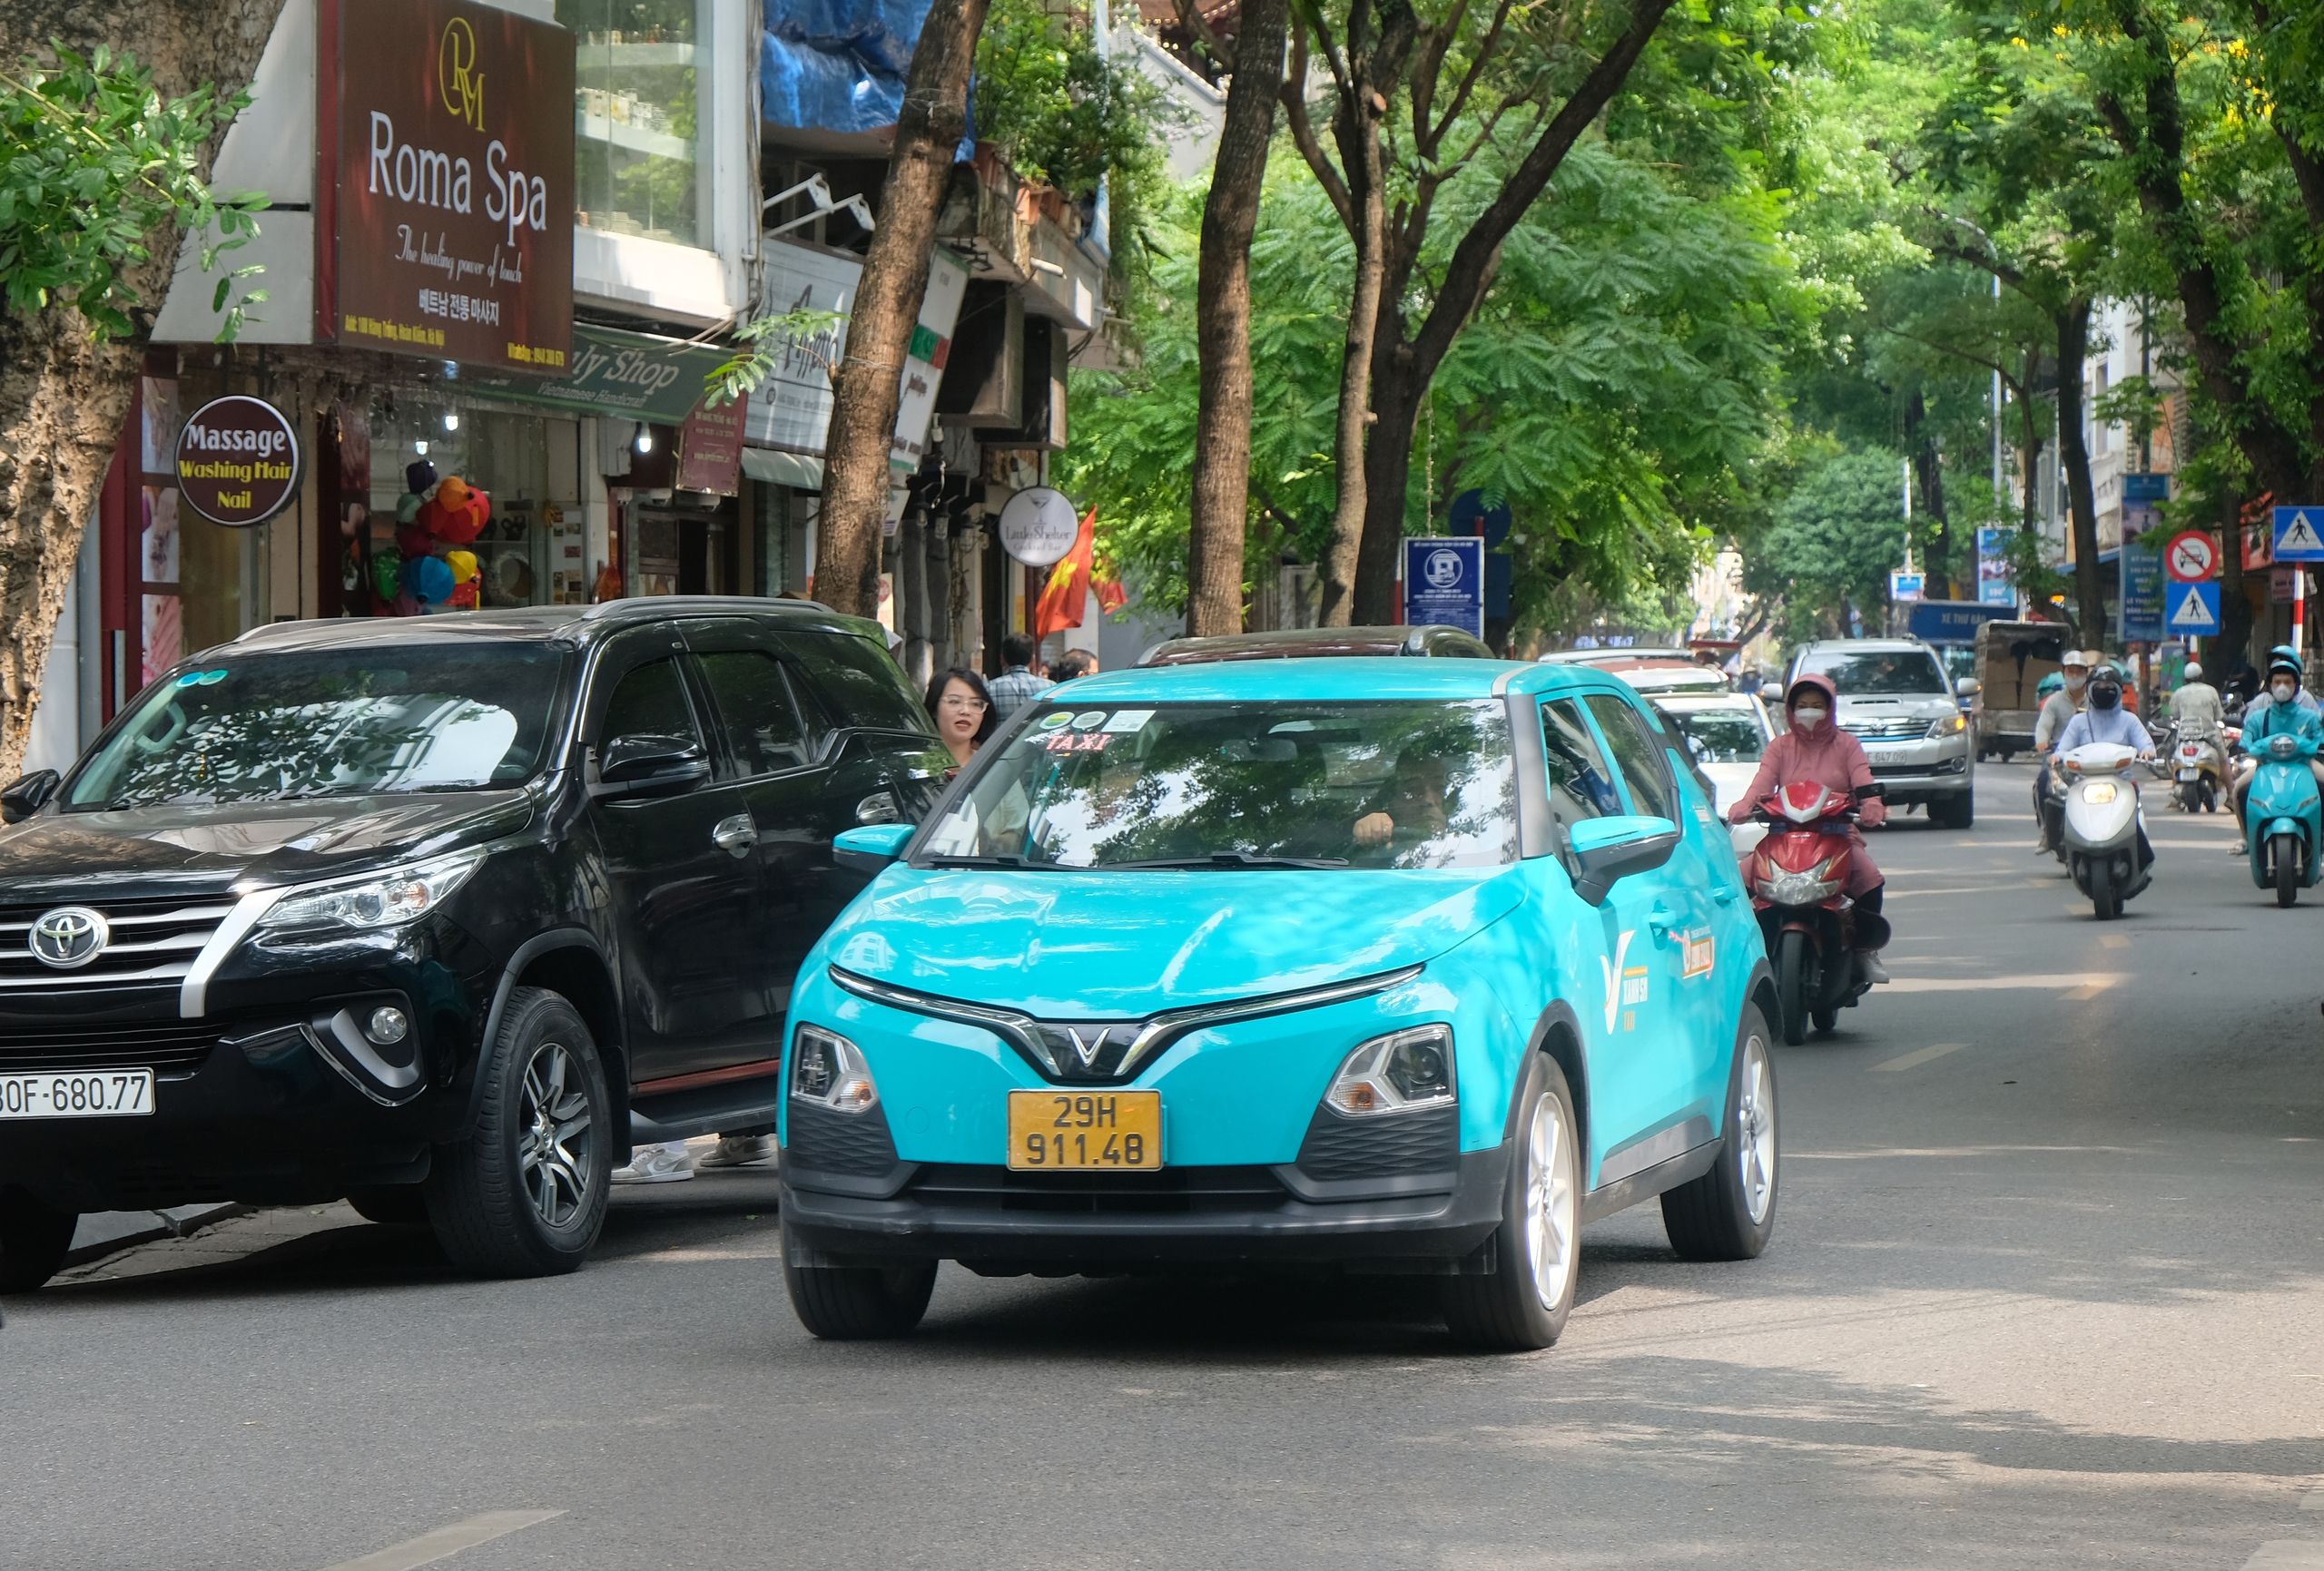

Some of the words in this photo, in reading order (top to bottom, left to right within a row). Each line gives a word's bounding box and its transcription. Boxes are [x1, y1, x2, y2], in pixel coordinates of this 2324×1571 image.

[369, 110, 472, 214] Roma
[485, 139, 547, 247] Spa
[395, 224, 418, 262] The
[420, 231, 454, 280] healing
[456, 260, 485, 281] power
[487, 243, 499, 288] of
[499, 251, 522, 283] touch
[419, 289, 448, 317] 베트남
[449, 294, 469, 321] 전통
[471, 298, 499, 326] 마사지
[603, 349, 679, 395] Shop
[186, 424, 286, 457] Massage
[179, 460, 251, 483] Washing
[254, 461, 291, 479] Hair
[217, 490, 251, 508] Nail
[1046, 732, 1112, 751] TAXI
[1053, 1095, 1117, 1128] 29H
[1027, 1132, 1144, 1165] 911.48
